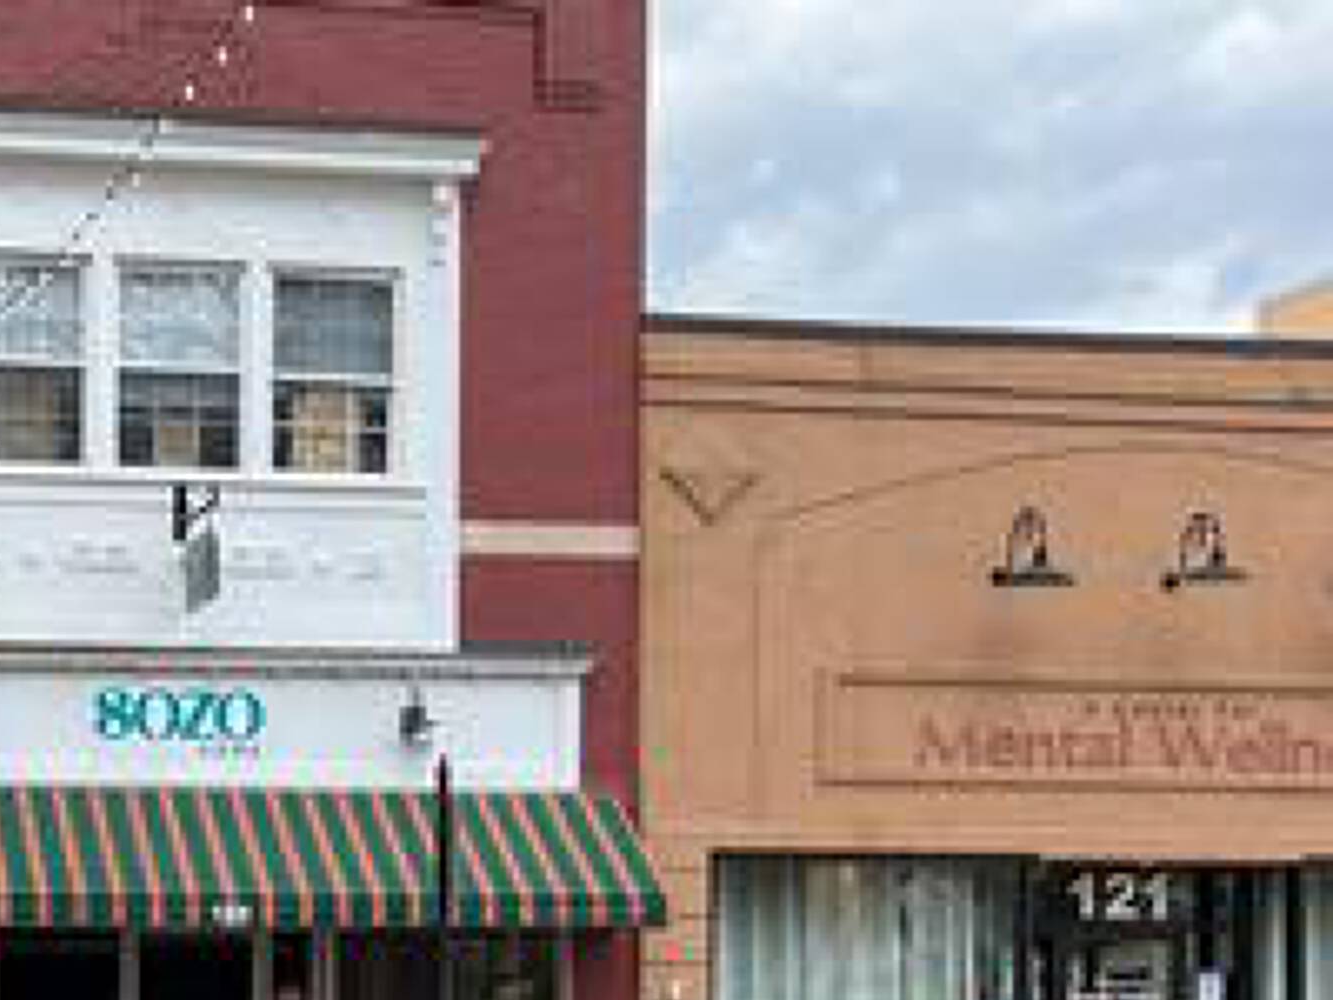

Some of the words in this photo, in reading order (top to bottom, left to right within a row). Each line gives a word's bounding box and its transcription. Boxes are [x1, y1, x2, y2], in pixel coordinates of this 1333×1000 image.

[96, 685, 266, 740] SOZO
[914, 710, 1129, 768] Mental
[1156, 714, 1333, 773] Welln
[1068, 869, 1167, 921] 121
